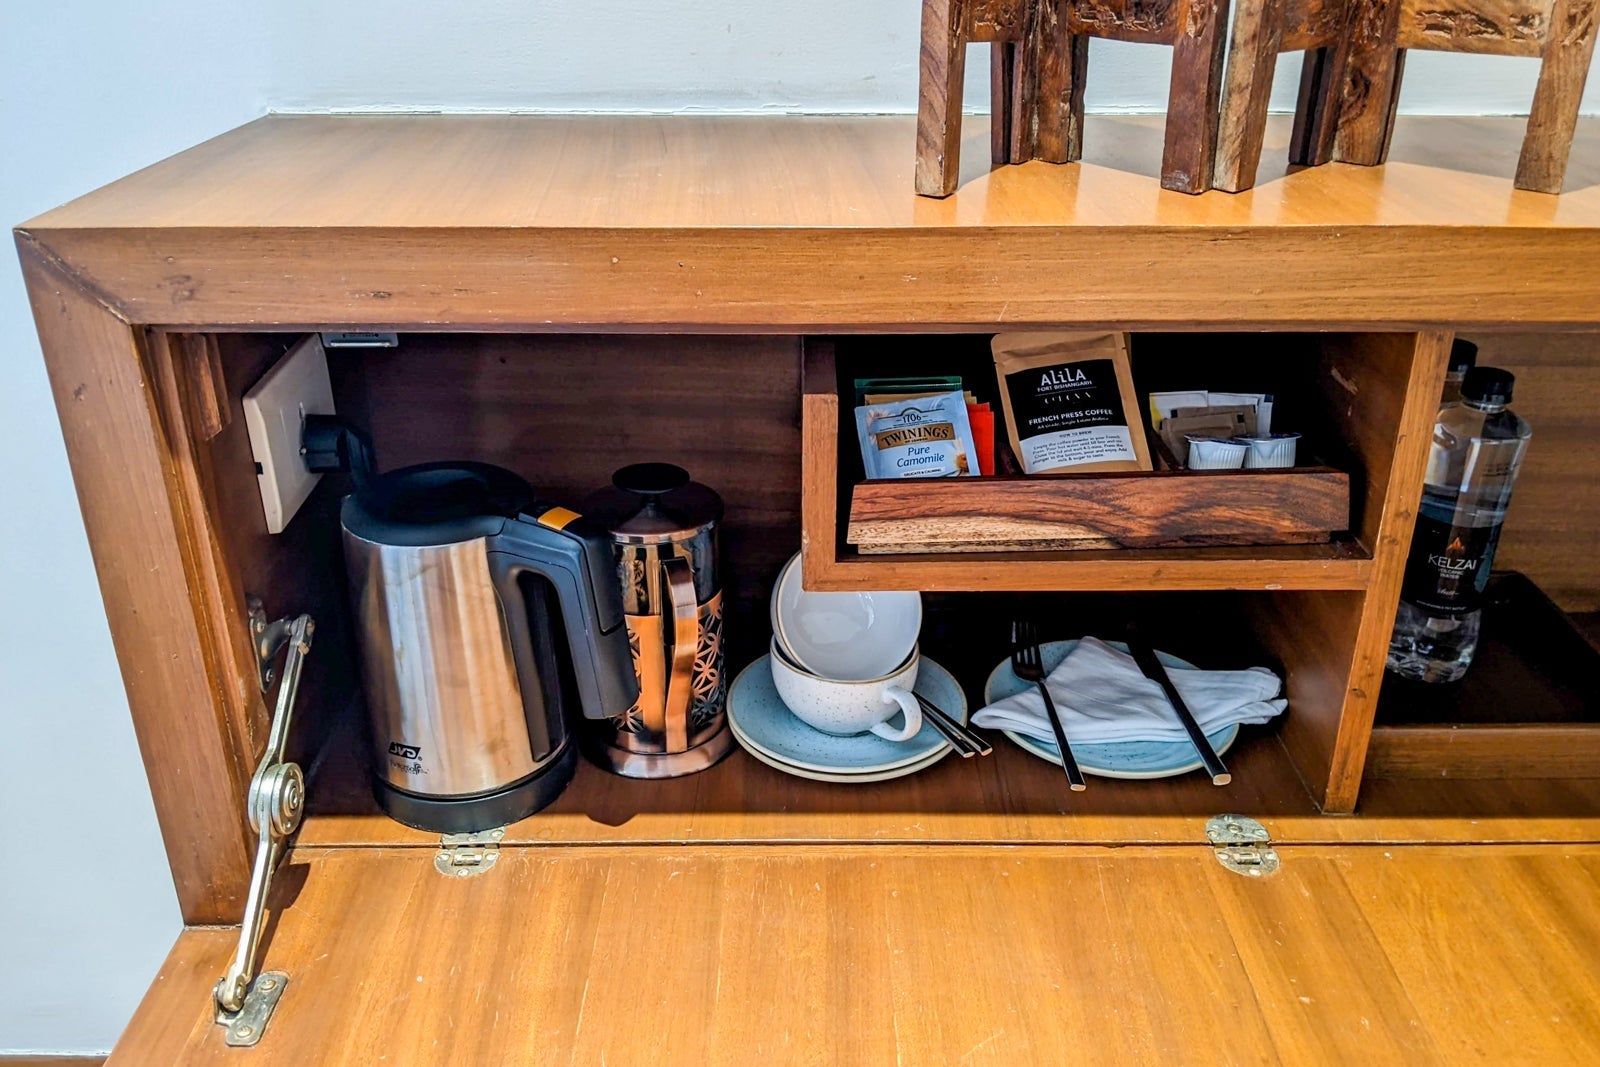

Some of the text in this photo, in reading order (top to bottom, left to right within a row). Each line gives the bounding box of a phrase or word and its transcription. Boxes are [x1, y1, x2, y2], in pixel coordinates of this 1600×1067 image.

[903, 413, 922, 423] 1706
[1029, 415, 1059, 426] FRENCH
[1061, 411, 1084, 419] PRESS
[881, 426, 950, 446] TWININGS
[908, 446, 930, 456] Pure
[897, 453, 945, 468] Camomile
[1428, 553, 1477, 570] KELZAI
